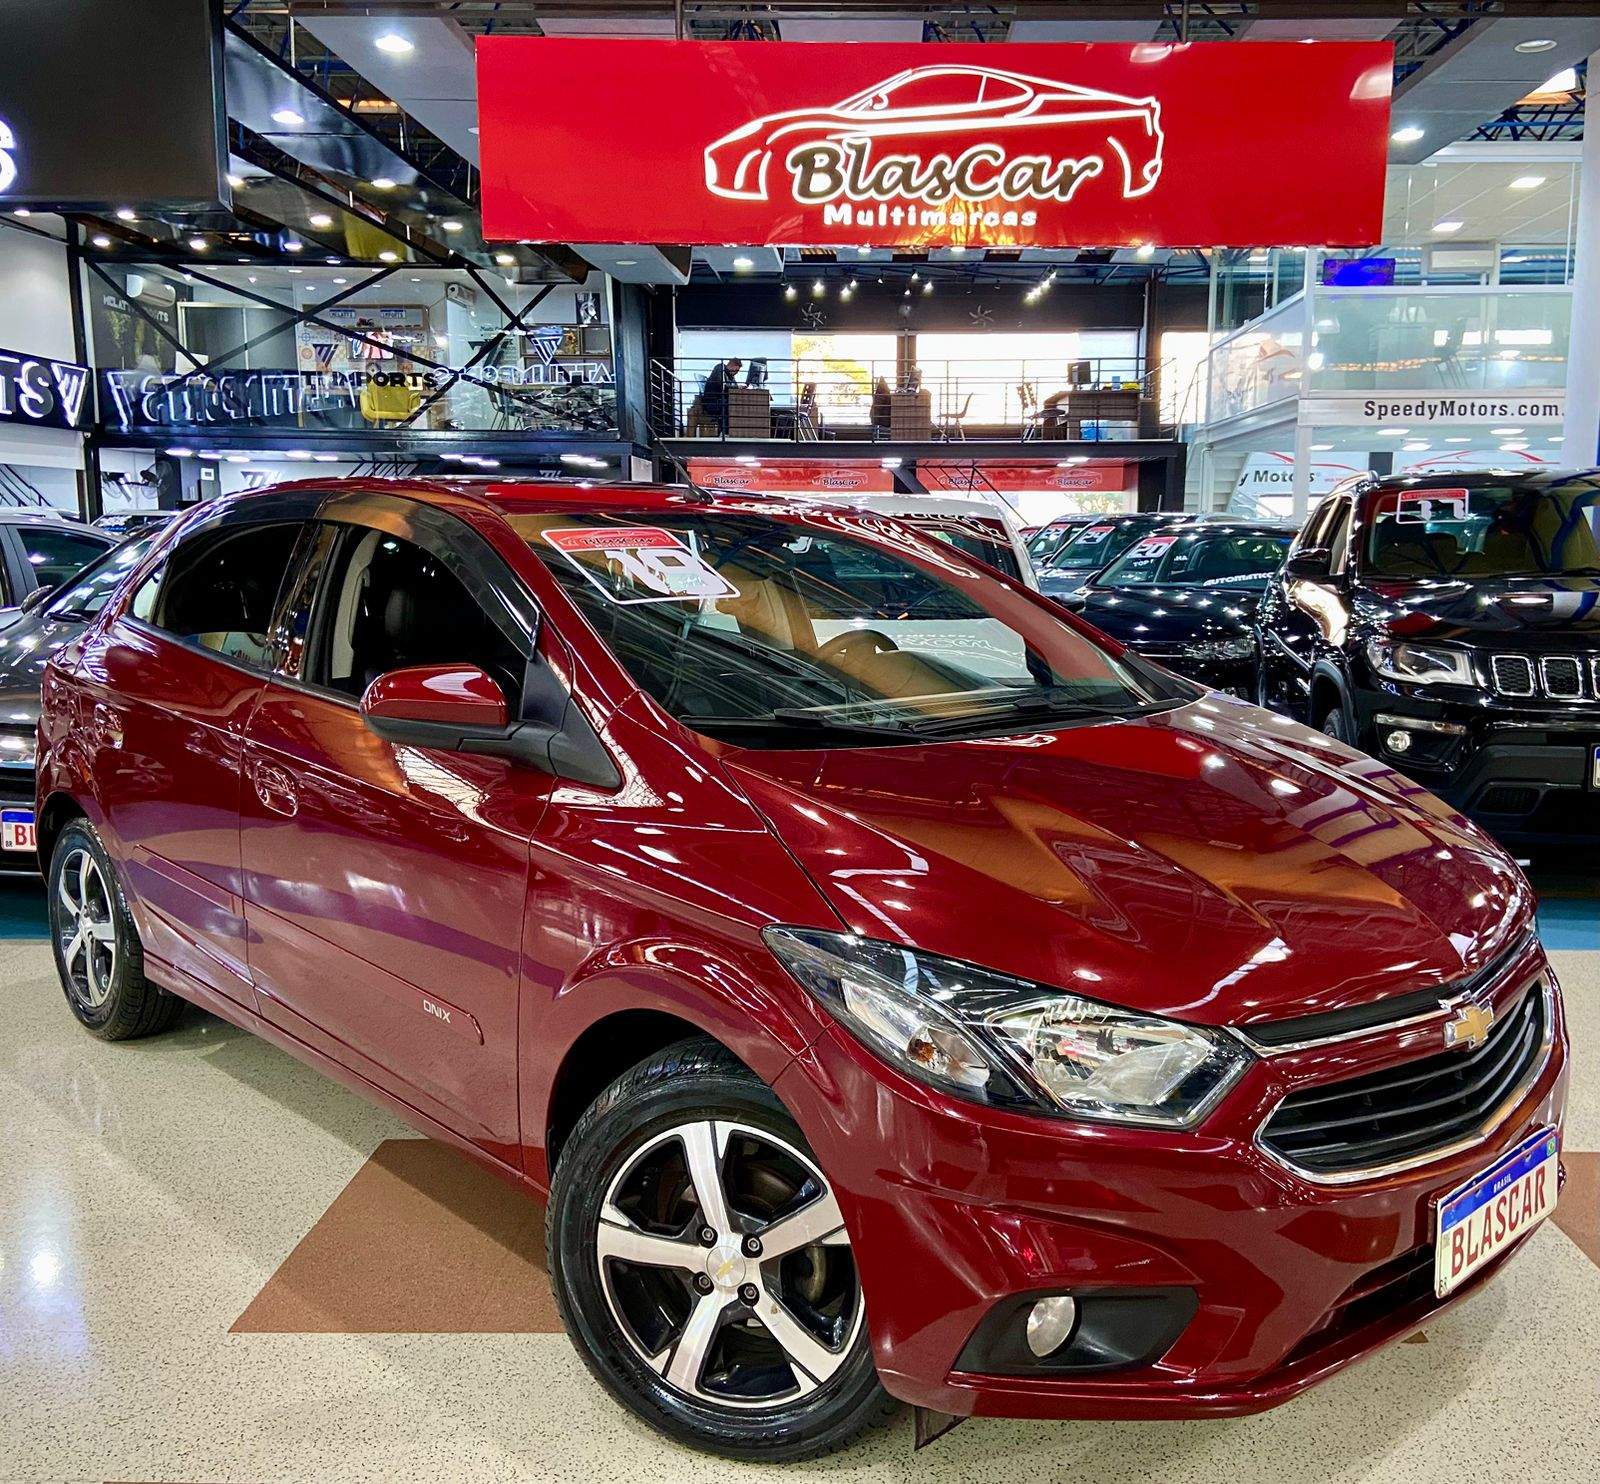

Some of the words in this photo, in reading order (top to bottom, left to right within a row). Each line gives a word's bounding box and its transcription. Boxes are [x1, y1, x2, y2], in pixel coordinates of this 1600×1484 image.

[789, 138, 1103, 204] BlasCar
[823, 204, 1038, 226] Multimarcas
[1253, 470, 1315, 483] Mots
[423, 999, 451, 1024] ONIX
[1493, 1173, 1512, 1194] BRASIL
[1451, 1165, 1546, 1279] BLASCAR
